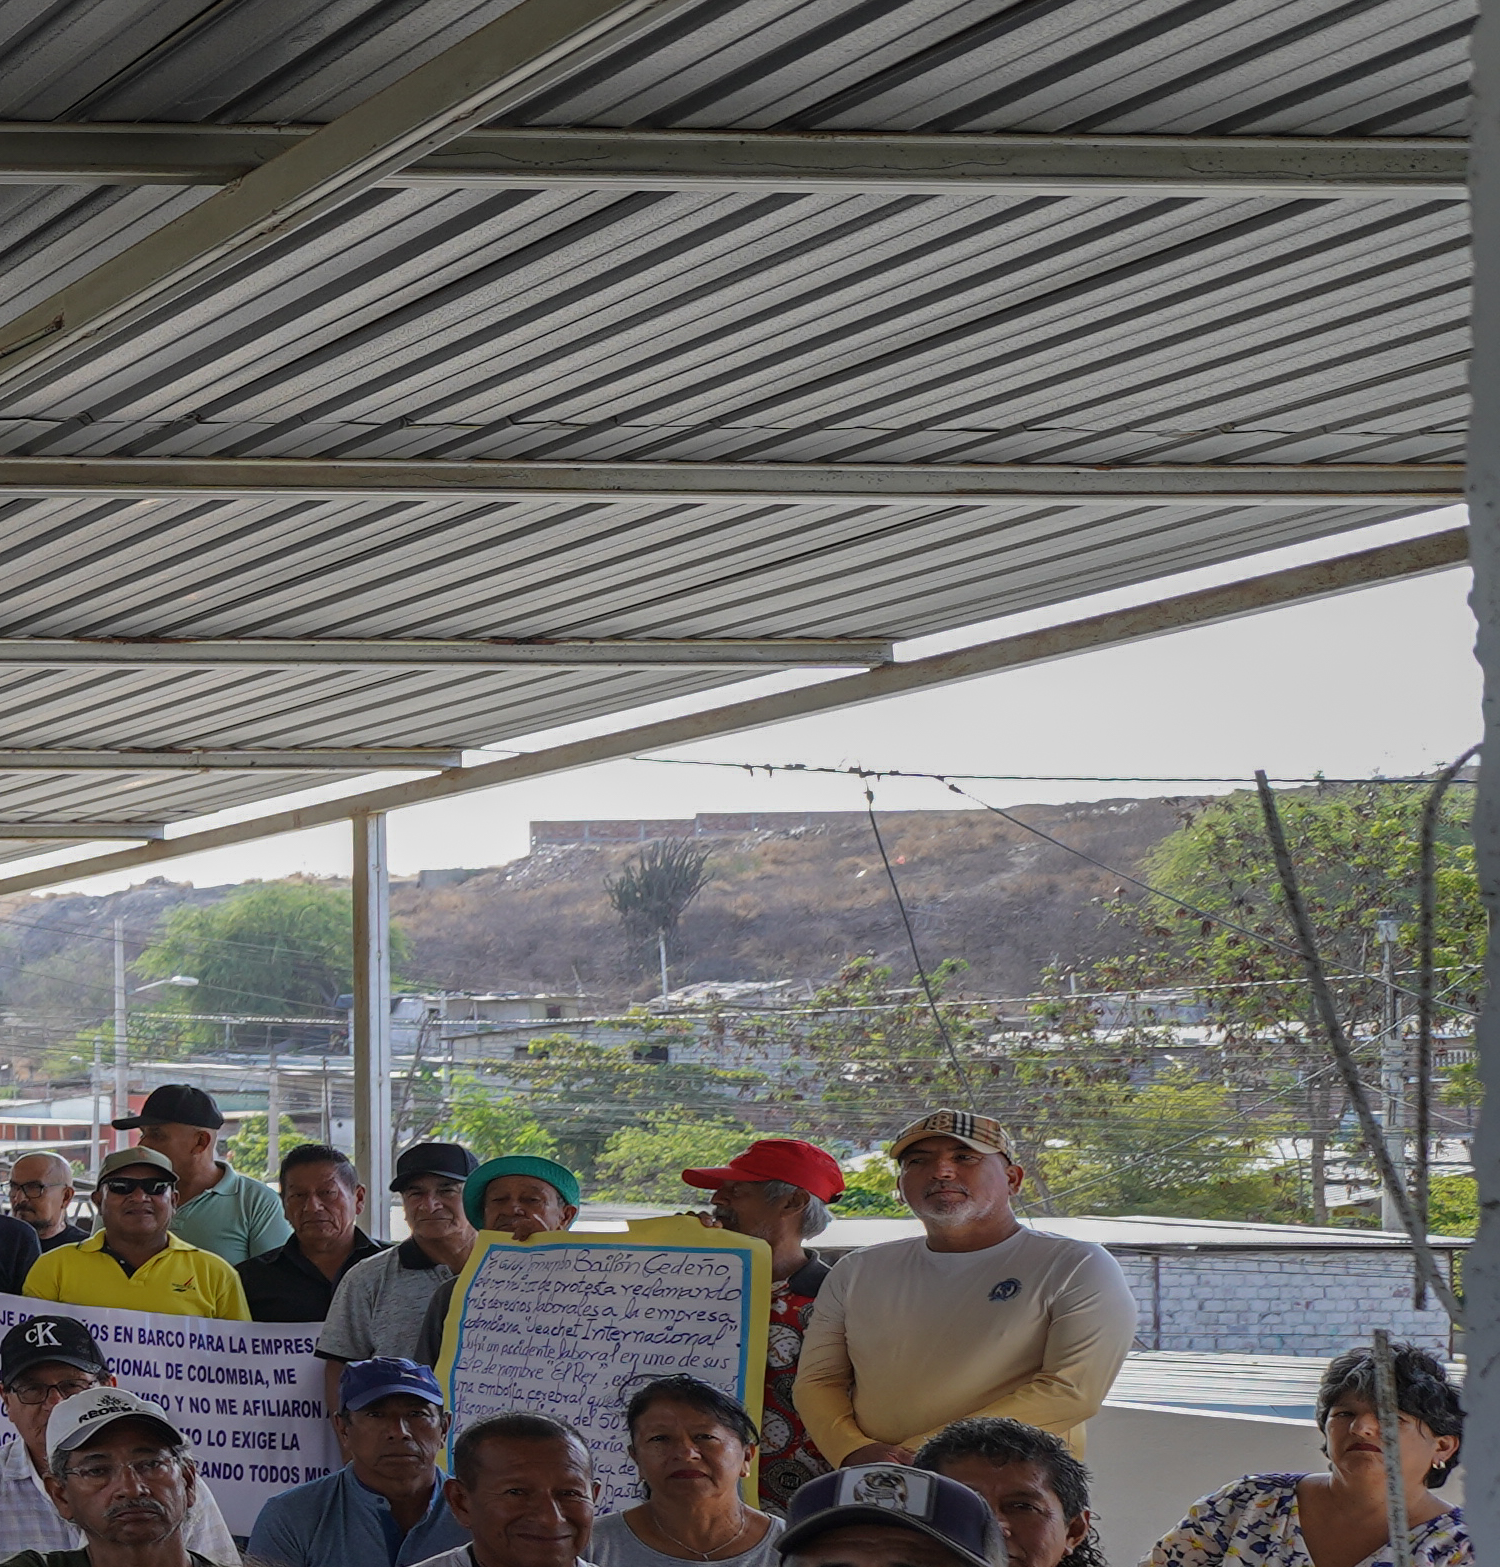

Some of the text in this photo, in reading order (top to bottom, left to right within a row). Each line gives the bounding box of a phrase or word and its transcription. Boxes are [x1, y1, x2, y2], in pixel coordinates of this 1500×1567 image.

[644, 1308, 736, 1324] empresa
[19, 1313, 34, 1326] PO
[114, 1326, 133, 1343] EN
[138, 1328, 185, 1349] BARCO
[189, 1333, 224, 1353] PARA
[229, 1336, 247, 1354] LA
[683, 1346, 700, 1367] de
[704, 1354, 730, 1370] sus
[165, 1362, 183, 1380] DE
[187, 1365, 269, 1389] COLOMBIA,
[274, 1368, 297, 1384] ME
[175, 1395, 184, 1412] Y
[189, 1398, 210, 1414] NO
[215, 1399, 238, 1415] ME
[243, 1399, 322, 1419] AFILIARON
[207, 1430, 226, 1447] LO
[232, 1431, 277, 1450] EXIGE
[282, 1433, 300, 1451] LA
[249, 1465, 300, 1484] TODOS
